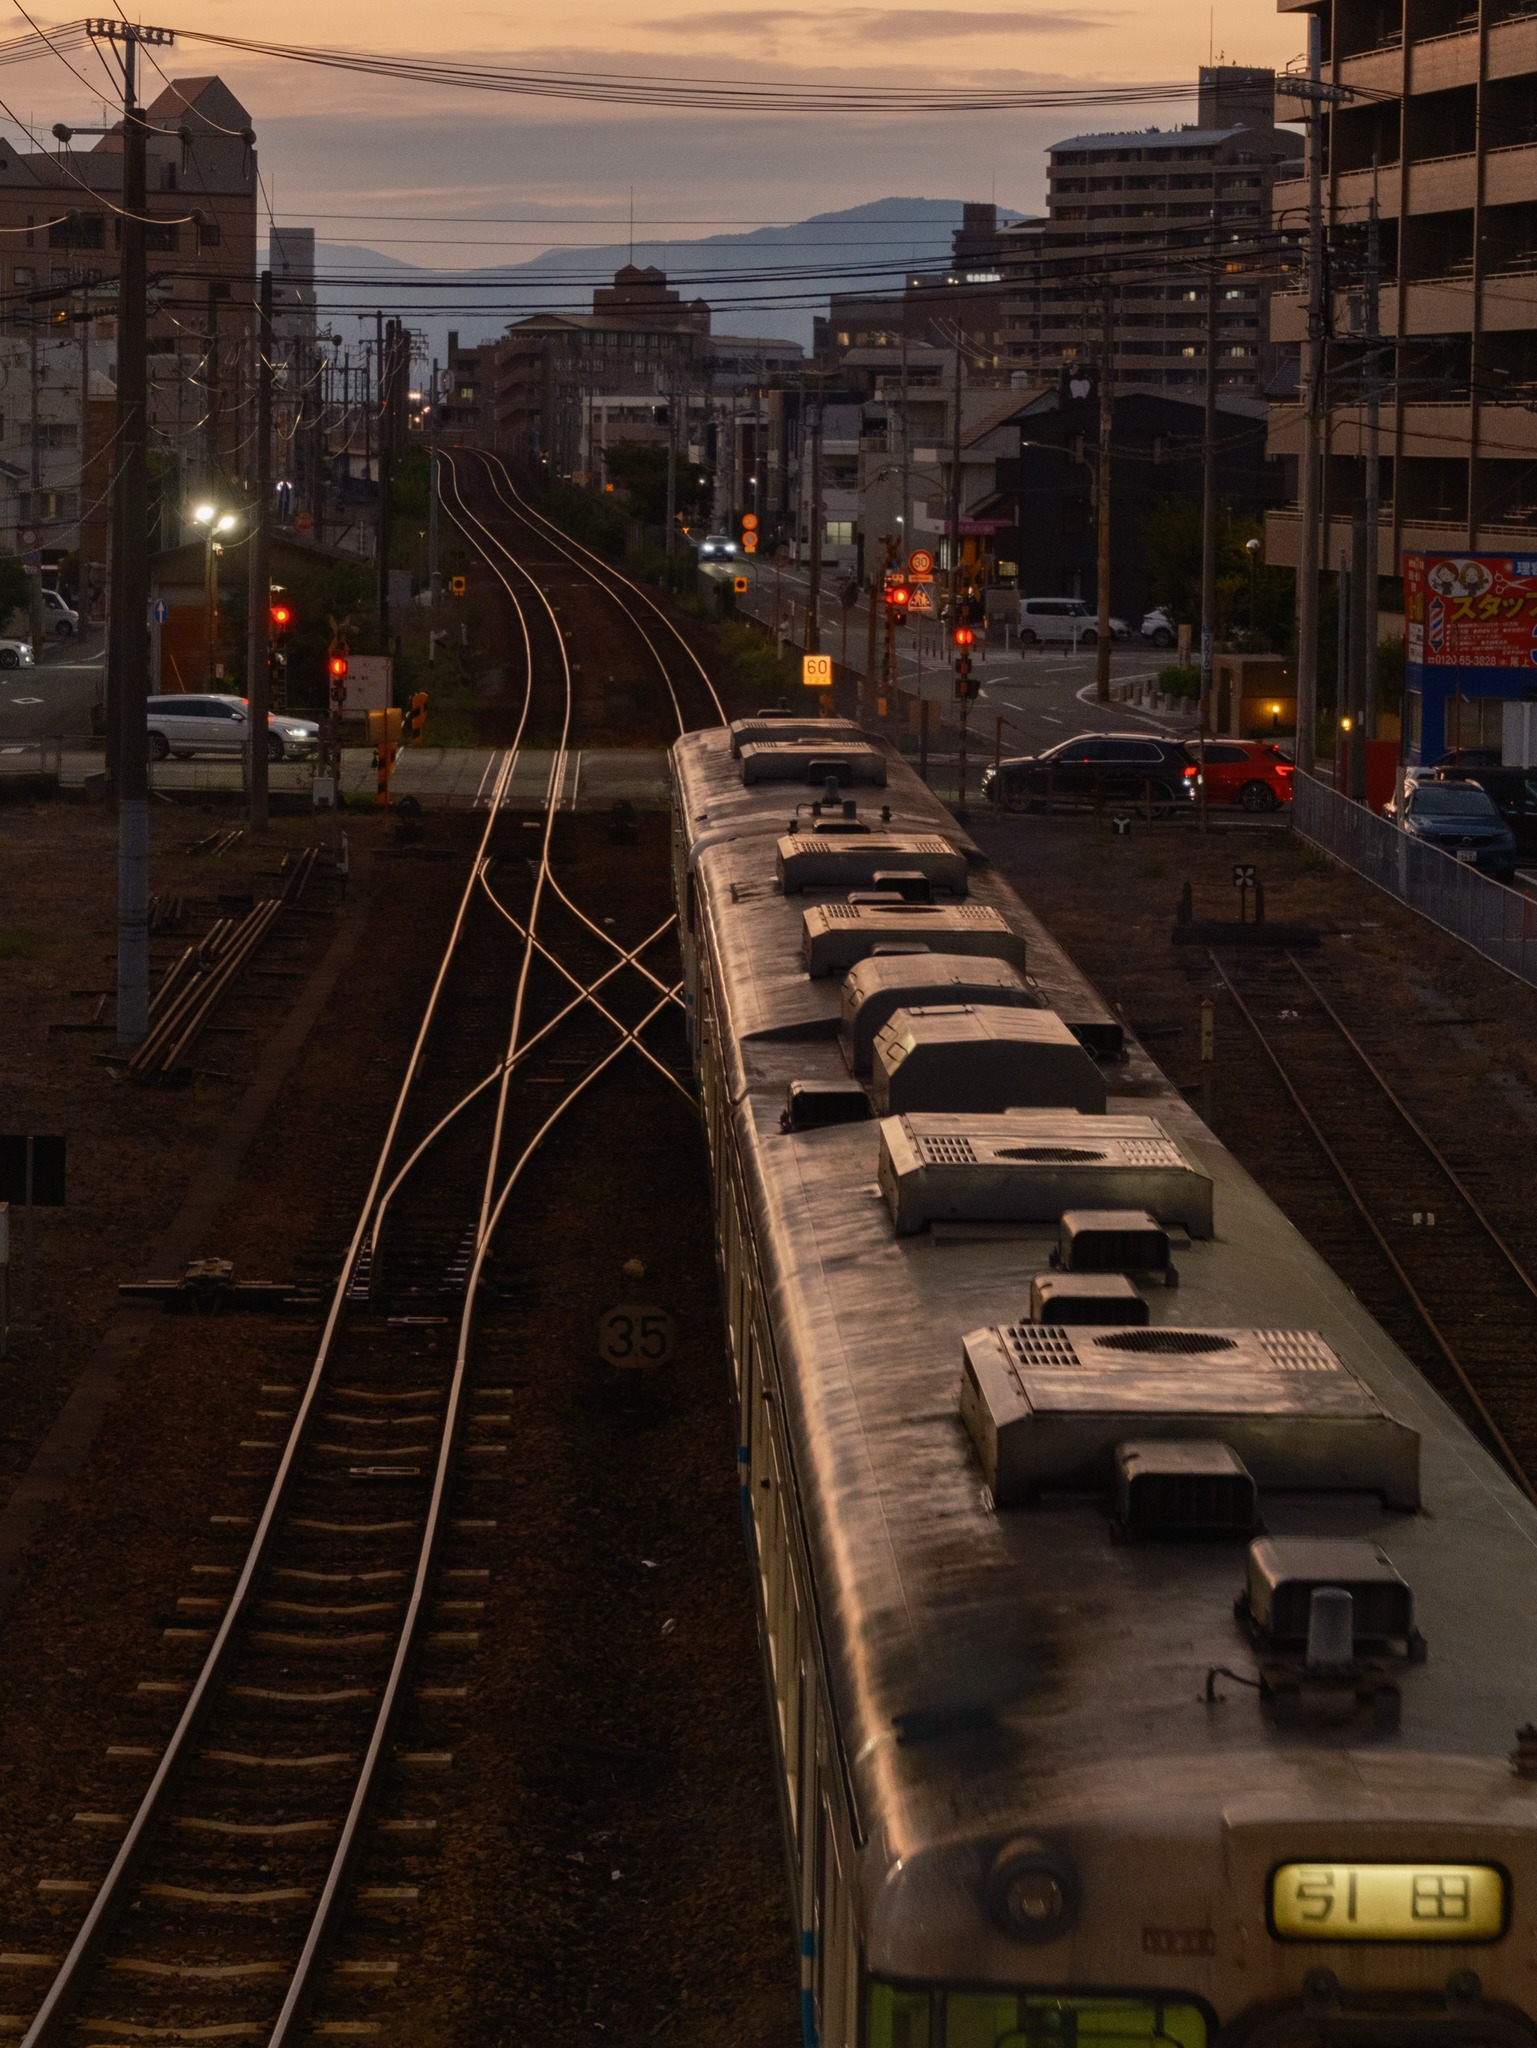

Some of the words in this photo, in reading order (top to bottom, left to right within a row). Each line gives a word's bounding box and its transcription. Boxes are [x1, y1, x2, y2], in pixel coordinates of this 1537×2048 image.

[914, 556, 928, 568] 30
[807, 659, 827, 675] 60
[1435, 655, 1497, 667] 012065-3828
[607, 1314, 667, 1358] 35
